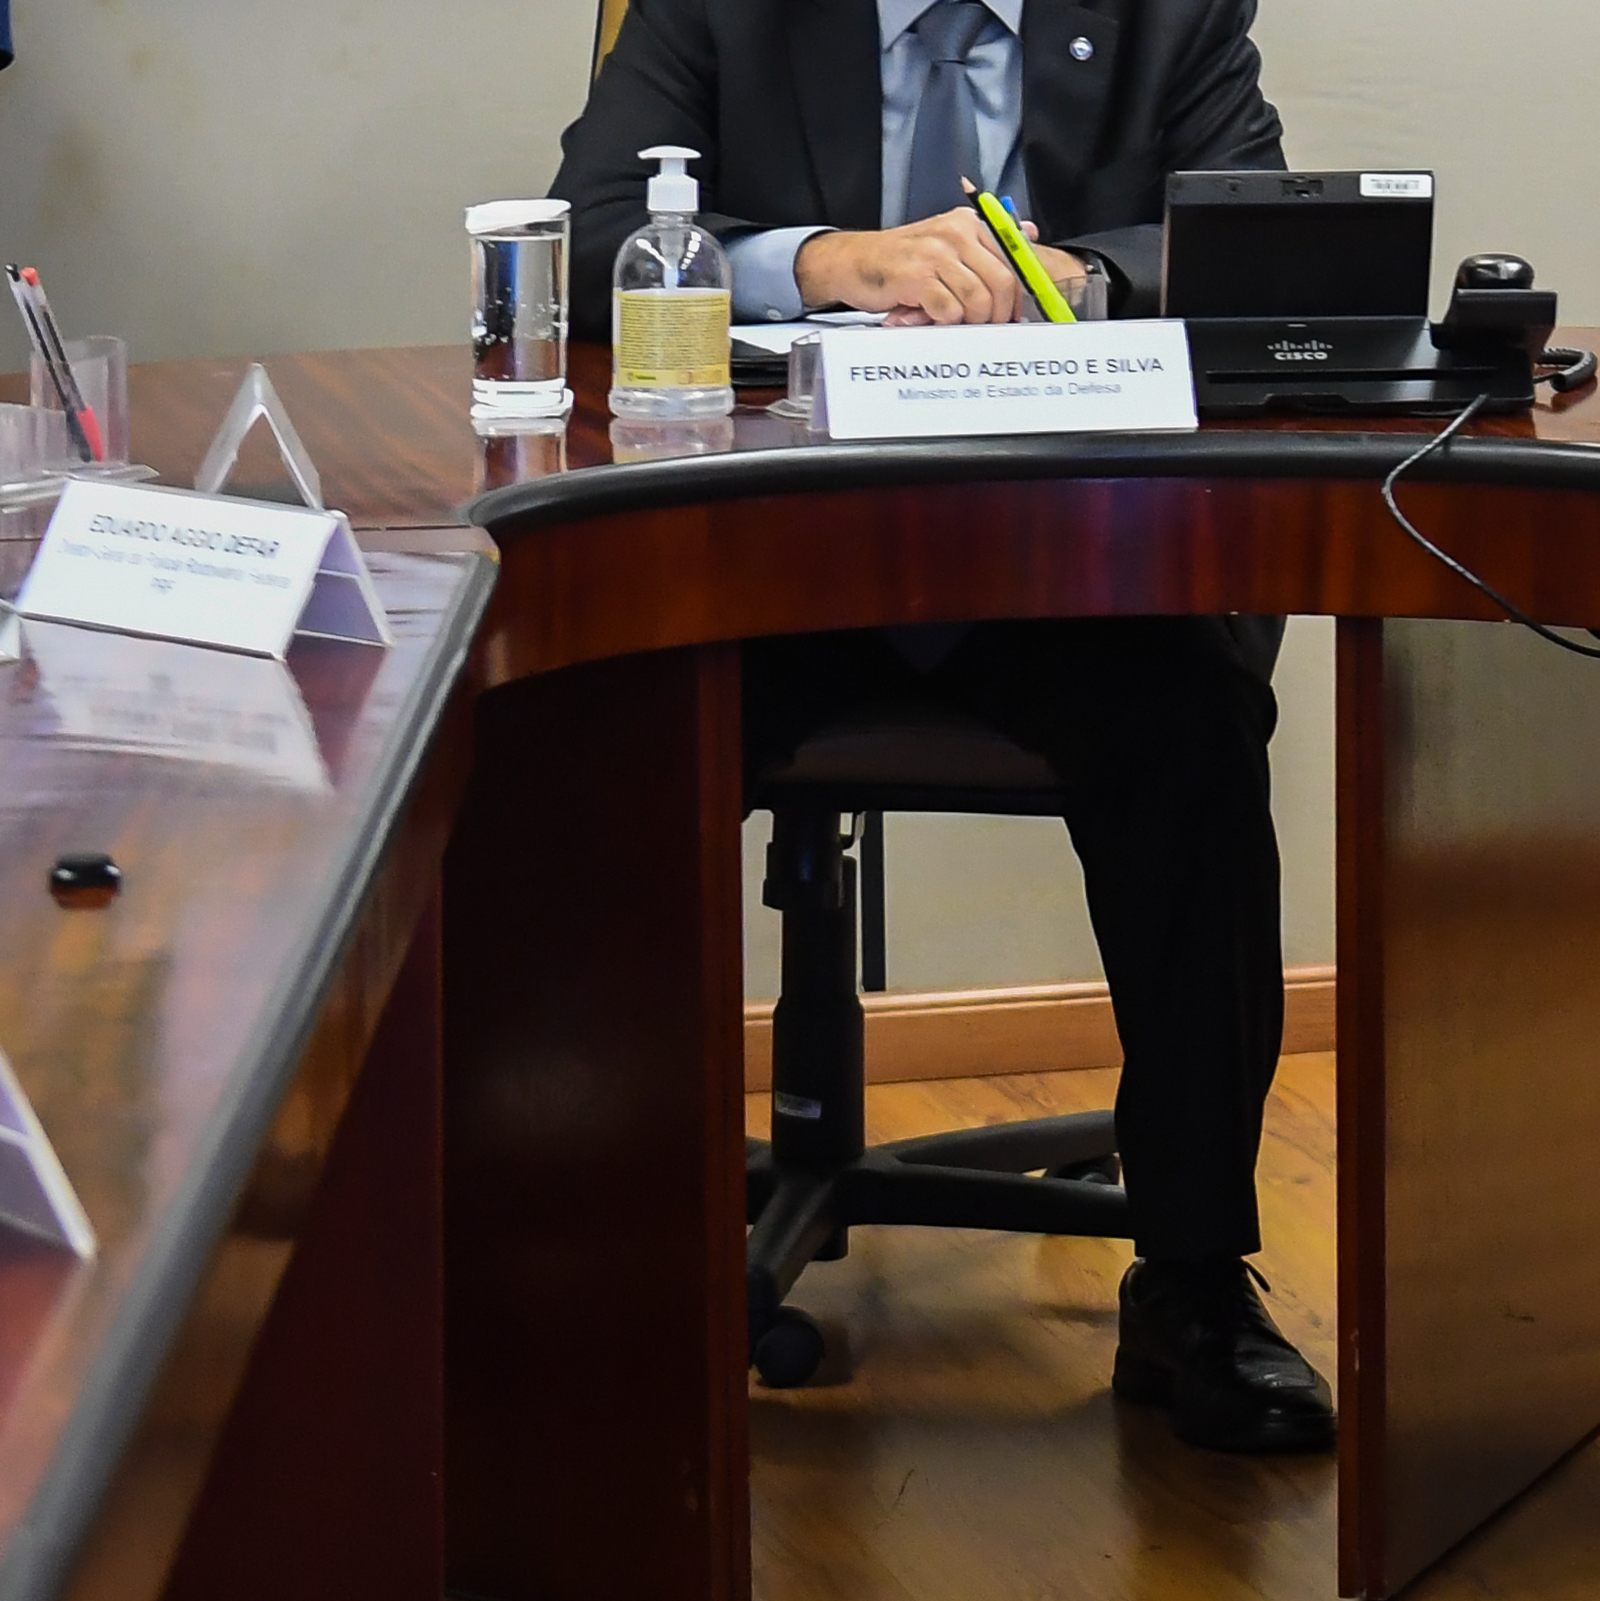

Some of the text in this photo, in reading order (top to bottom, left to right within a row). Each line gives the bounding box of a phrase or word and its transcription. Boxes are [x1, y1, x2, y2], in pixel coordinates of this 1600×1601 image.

[850, 358, 1164, 382] FERNANDO AZEVEDO E SILVA
[897, 381, 1122, 401] Ministro de Estado da Defesa
